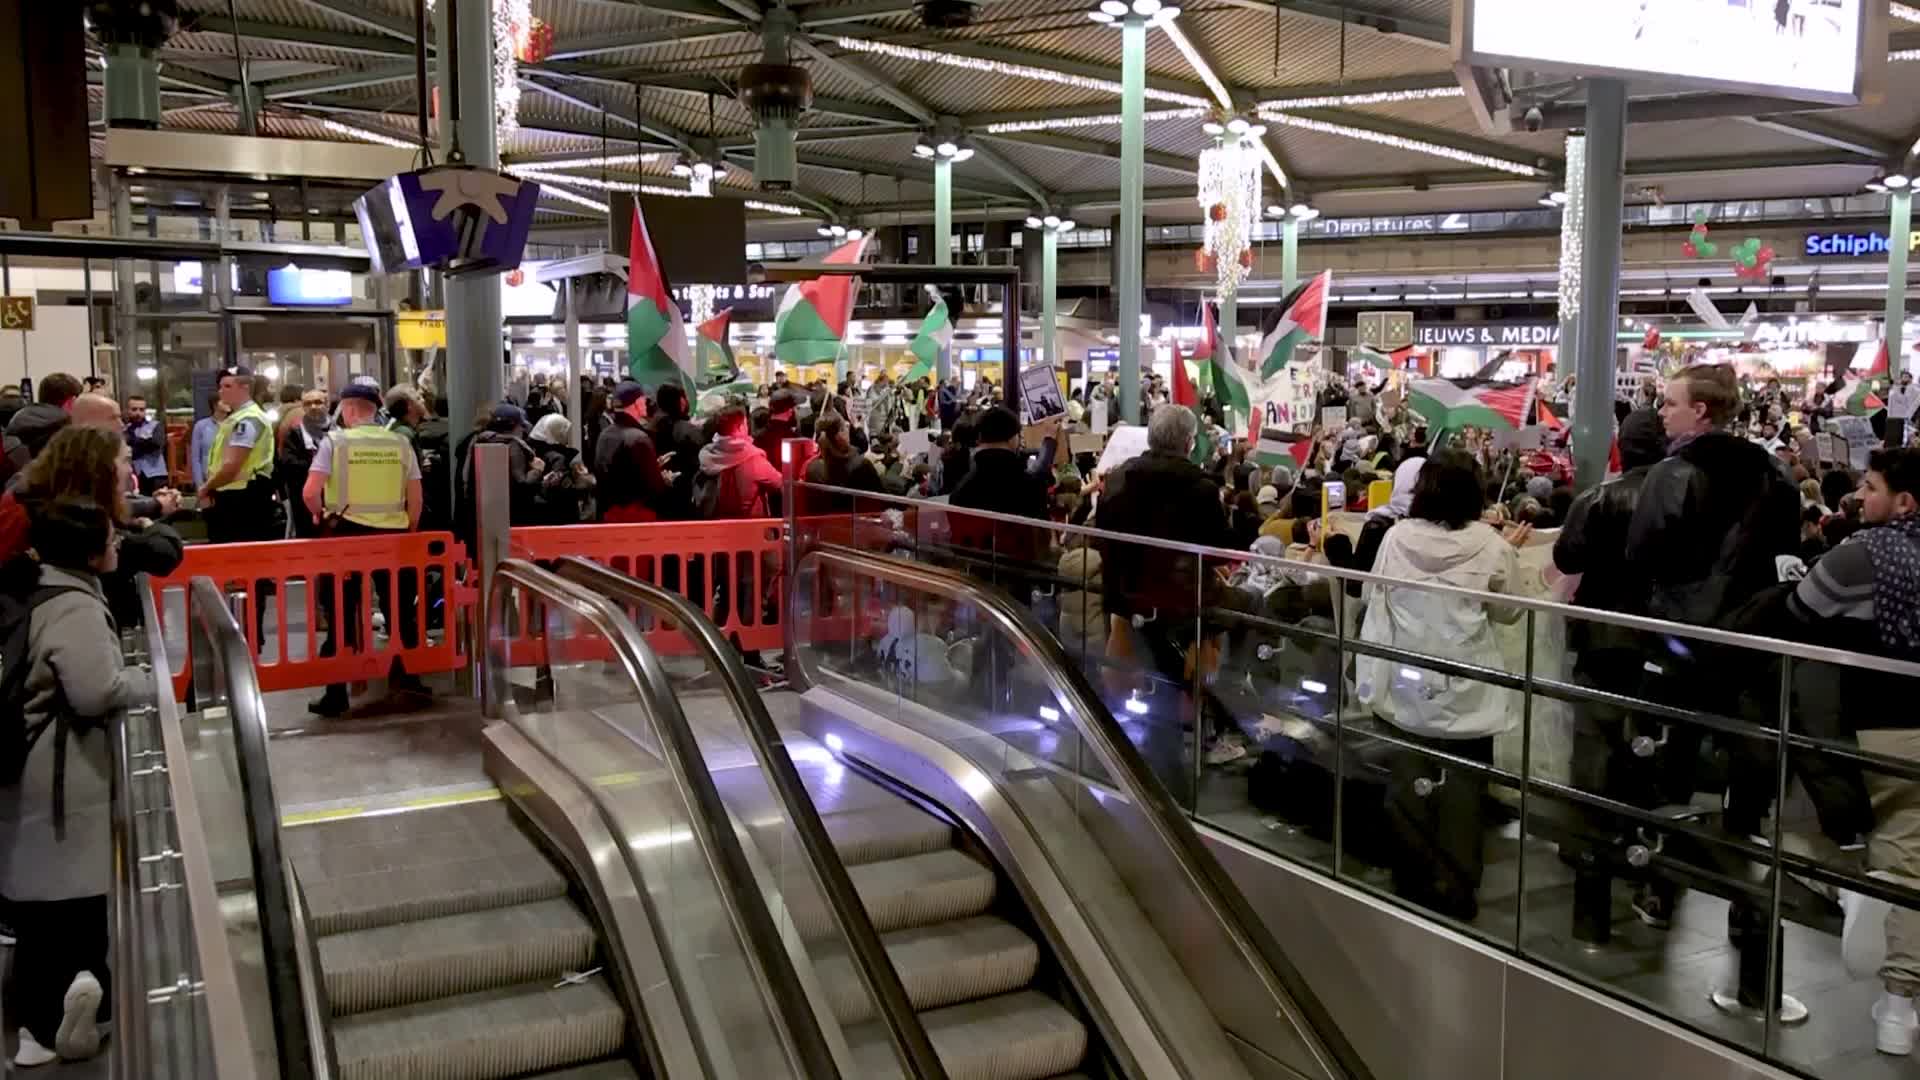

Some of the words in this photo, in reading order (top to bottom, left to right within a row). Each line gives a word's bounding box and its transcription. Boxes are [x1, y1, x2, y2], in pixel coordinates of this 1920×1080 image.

[1326, 218, 1433, 236] Departures
[1806, 232, 1893, 256] Schipho
[1418, 327, 1475, 343] IEUWS
[1480, 327, 1494, 343] &
